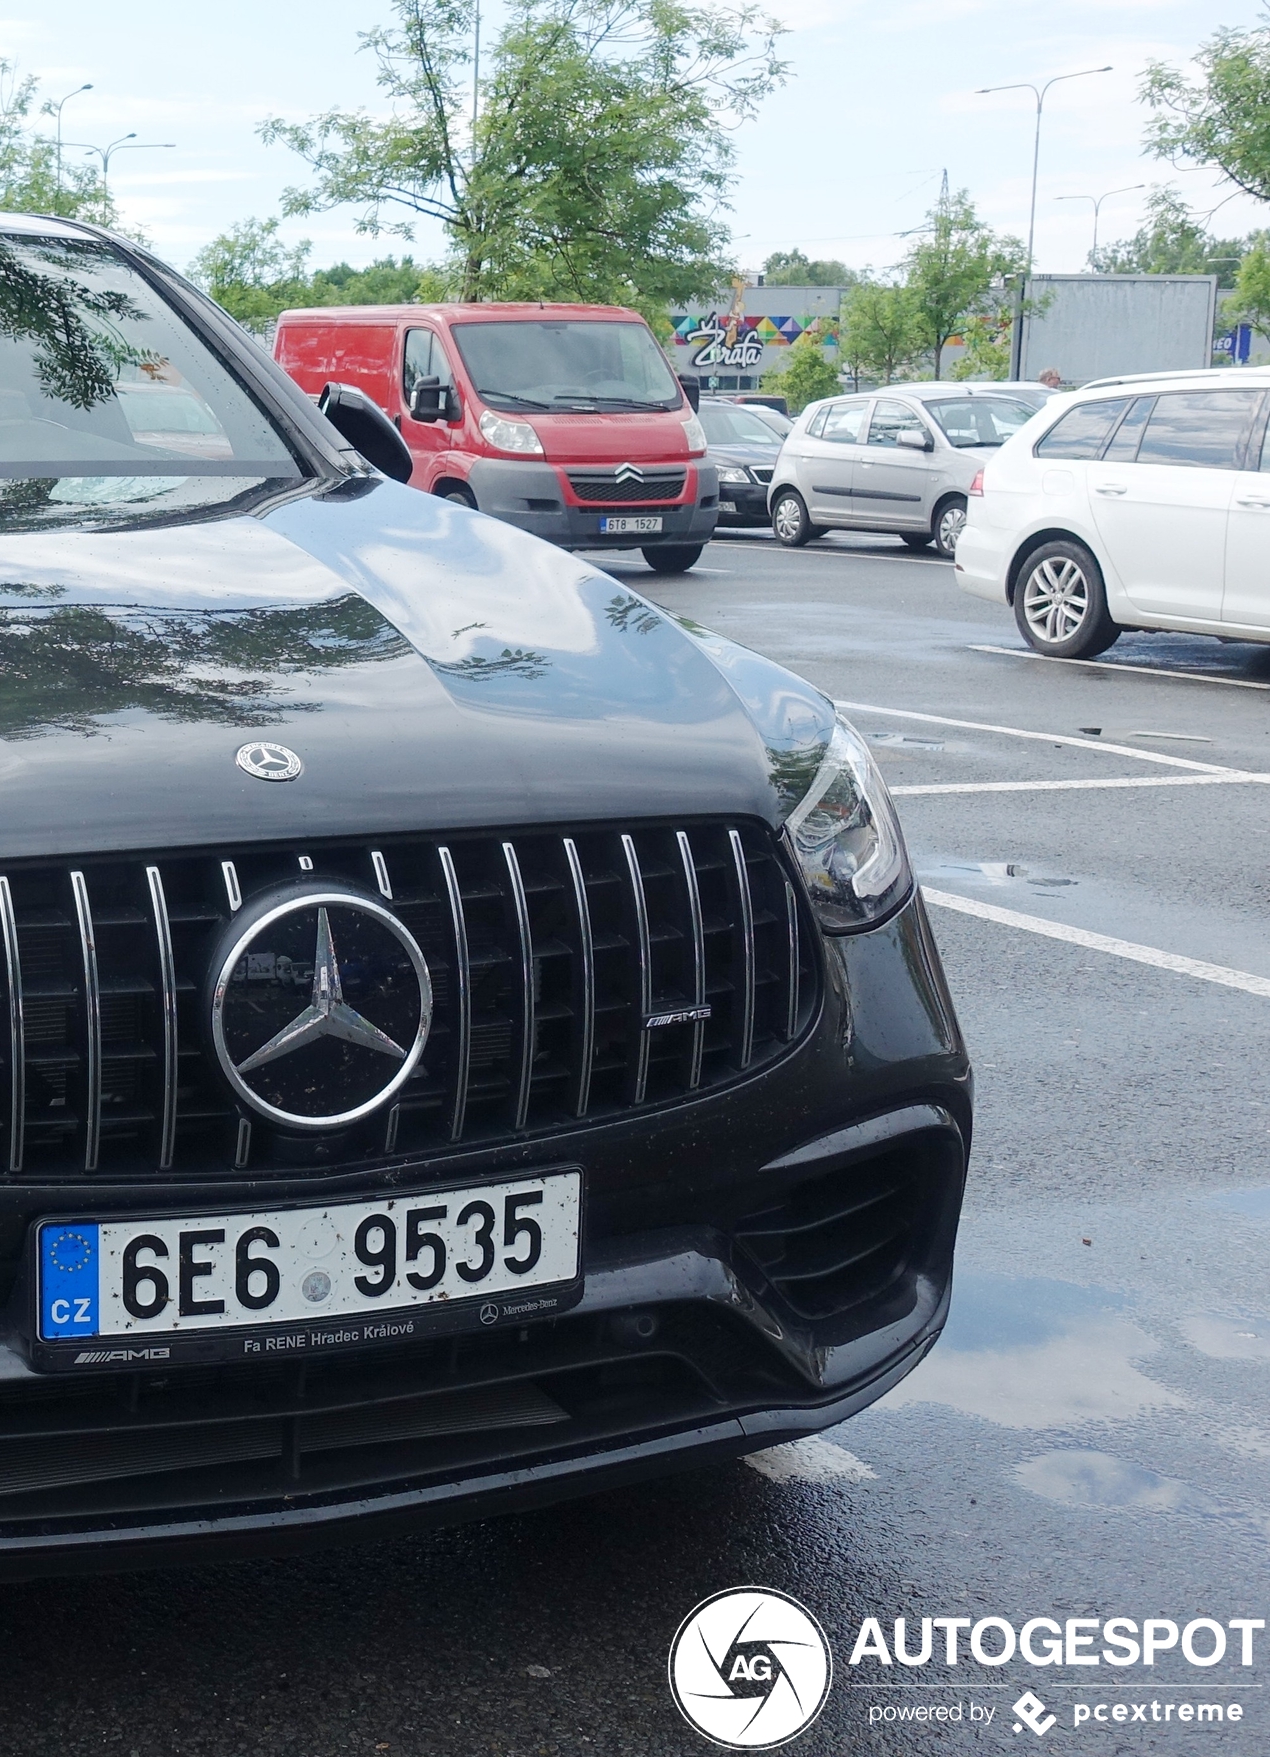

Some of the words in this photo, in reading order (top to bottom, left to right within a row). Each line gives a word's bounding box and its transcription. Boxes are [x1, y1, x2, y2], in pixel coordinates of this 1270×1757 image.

[609, 519, 627, 530] 6T8
[635, 519, 658, 530] 1527
[123, 1226, 280, 1319] 6E6
[354, 1190, 543, 1297] 9535
[51, 1298, 91, 1324] CZ
[502, 1299, 558, 1316] Mercedes-Benz
[244, 1340, 260, 1352] Fa
[266, 1335, 306, 1350] RENE
[312, 1330, 359, 1346] Hradec
[364, 1320, 414, 1339] Králové
[109, 1348, 170, 1362] AMG
